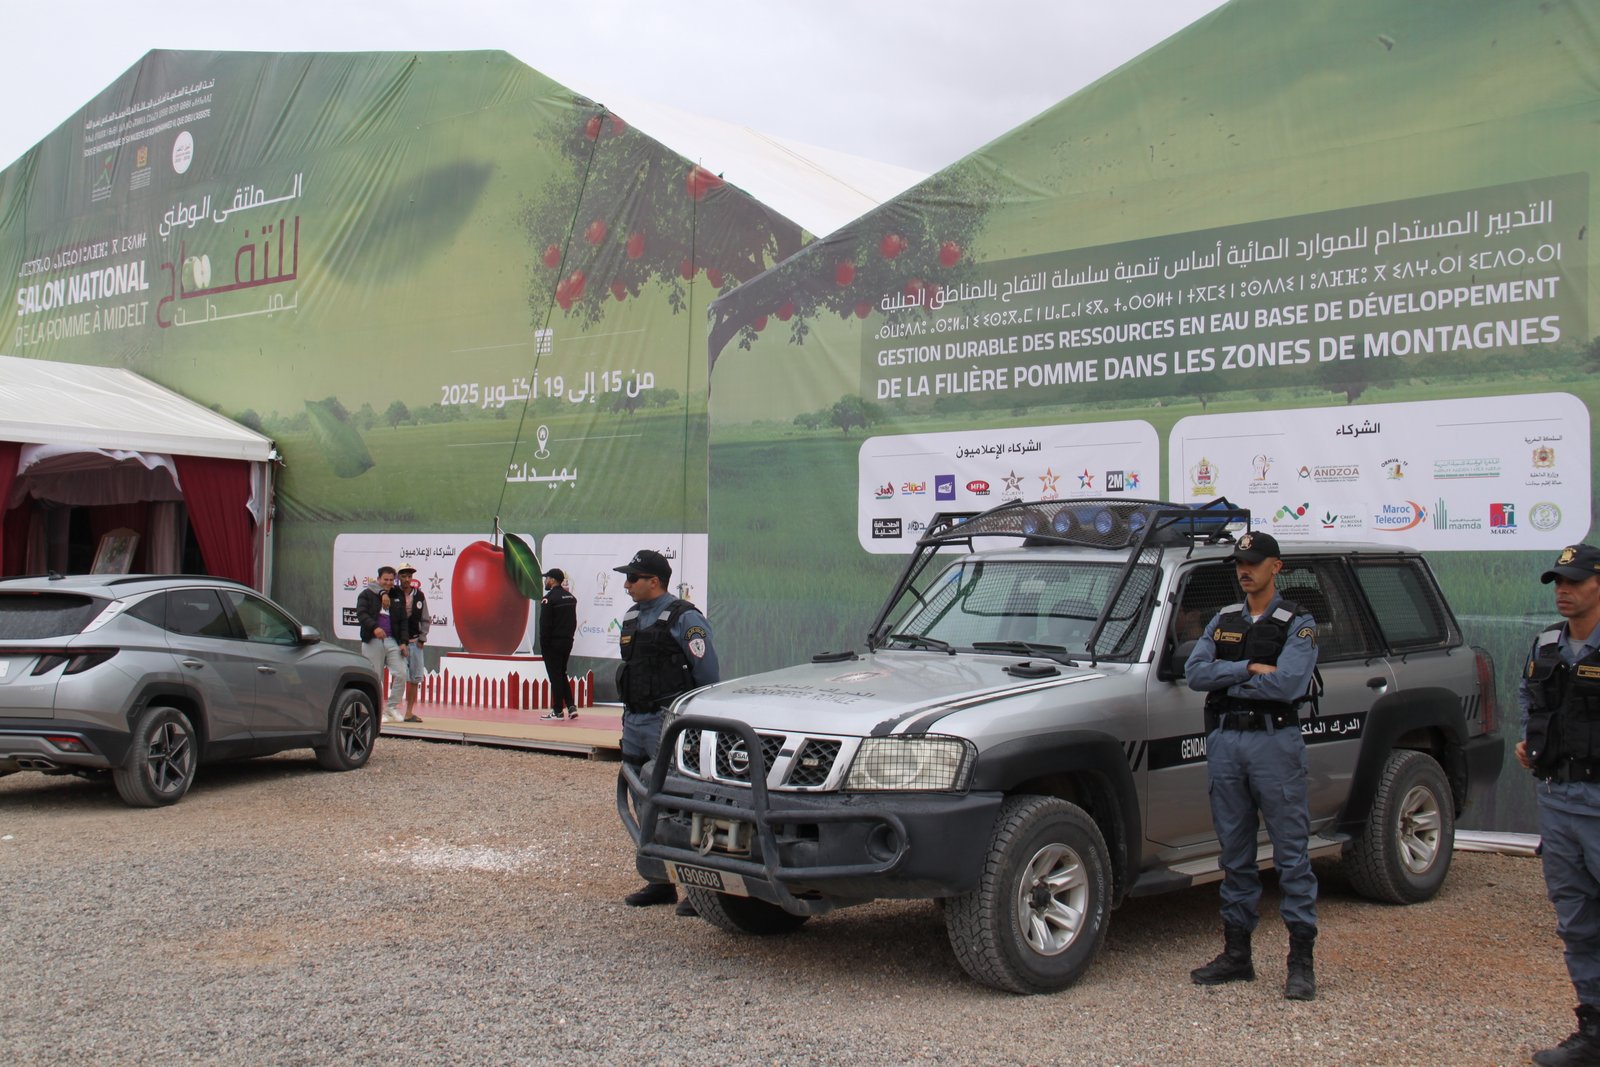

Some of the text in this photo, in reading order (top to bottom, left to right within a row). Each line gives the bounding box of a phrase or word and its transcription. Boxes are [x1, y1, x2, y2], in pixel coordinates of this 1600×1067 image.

[159, 195, 211, 242] الوطني
[881, 200, 1552, 313] التدبير المستدام للموارد المائية أساس تنمية سلسلة التفاح بالمناطق الجبلية
[18, 260, 149, 316] SALON NATIONAL
[1045, 302, 1081, 320] ⵡⴰⵎⴰⵏ
[1085, 300, 1109, 316] ⵉⴳⴰ
[1186, 284, 1226, 304] ⵜⴳⵎⵉ
[15, 301, 149, 347] DE LA POMME À MIDELT
[878, 276, 1560, 367] GESTION DURABLE DES RESSOURCES EN EAU BASE DE DÉVELOPPEMENT
[877, 315, 1561, 400] DE LA FILIÈRE POMME DANS LES ZONES DE MONTAGNES
[440, 368, 655, 409] من 15 إلى 19 أكتوبر 2025
[1336, 419, 1380, 438] الشركاء
[956, 440, 1042, 460] الشركاء الإعلاميون
[1108, 474, 1123, 489] 2M
[1314, 468, 1360, 478] ANDZOA
[1374, 514, 1410, 524] Telecom
[1382, 504, 1410, 514] Maroc
[1448, 522, 1482, 530] mamda
[400, 544, 456, 561] الشركاء الإعلاميون
[1301, 718, 1360, 736] الدرك الملك
[678, 866, 720, 887] 190608
